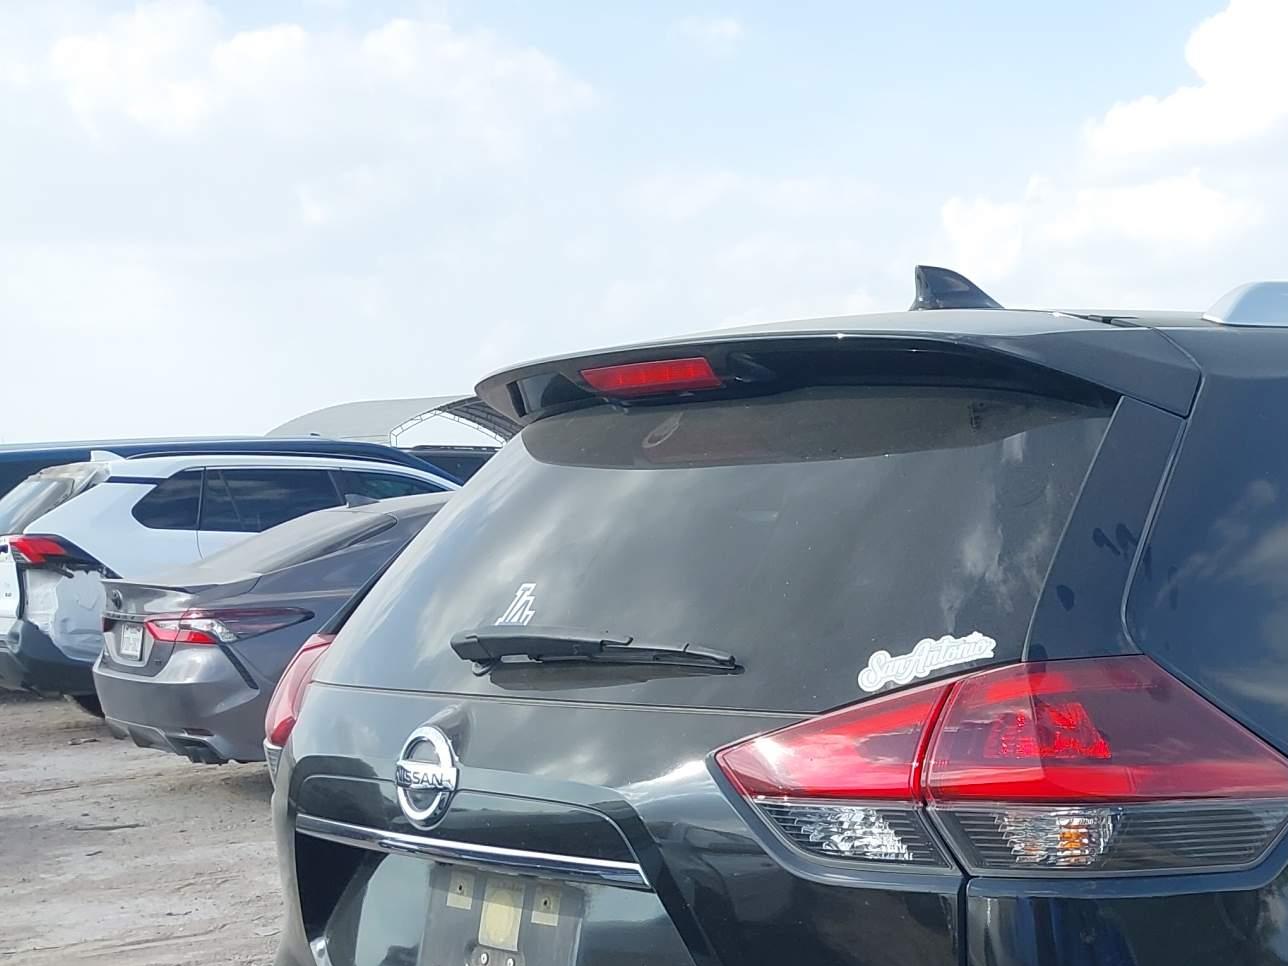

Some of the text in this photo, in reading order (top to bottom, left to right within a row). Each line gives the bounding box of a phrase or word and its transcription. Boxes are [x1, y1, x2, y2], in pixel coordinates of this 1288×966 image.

[858, 631, 997, 691] San Antonio
[397, 766, 444, 787] NISSAN
